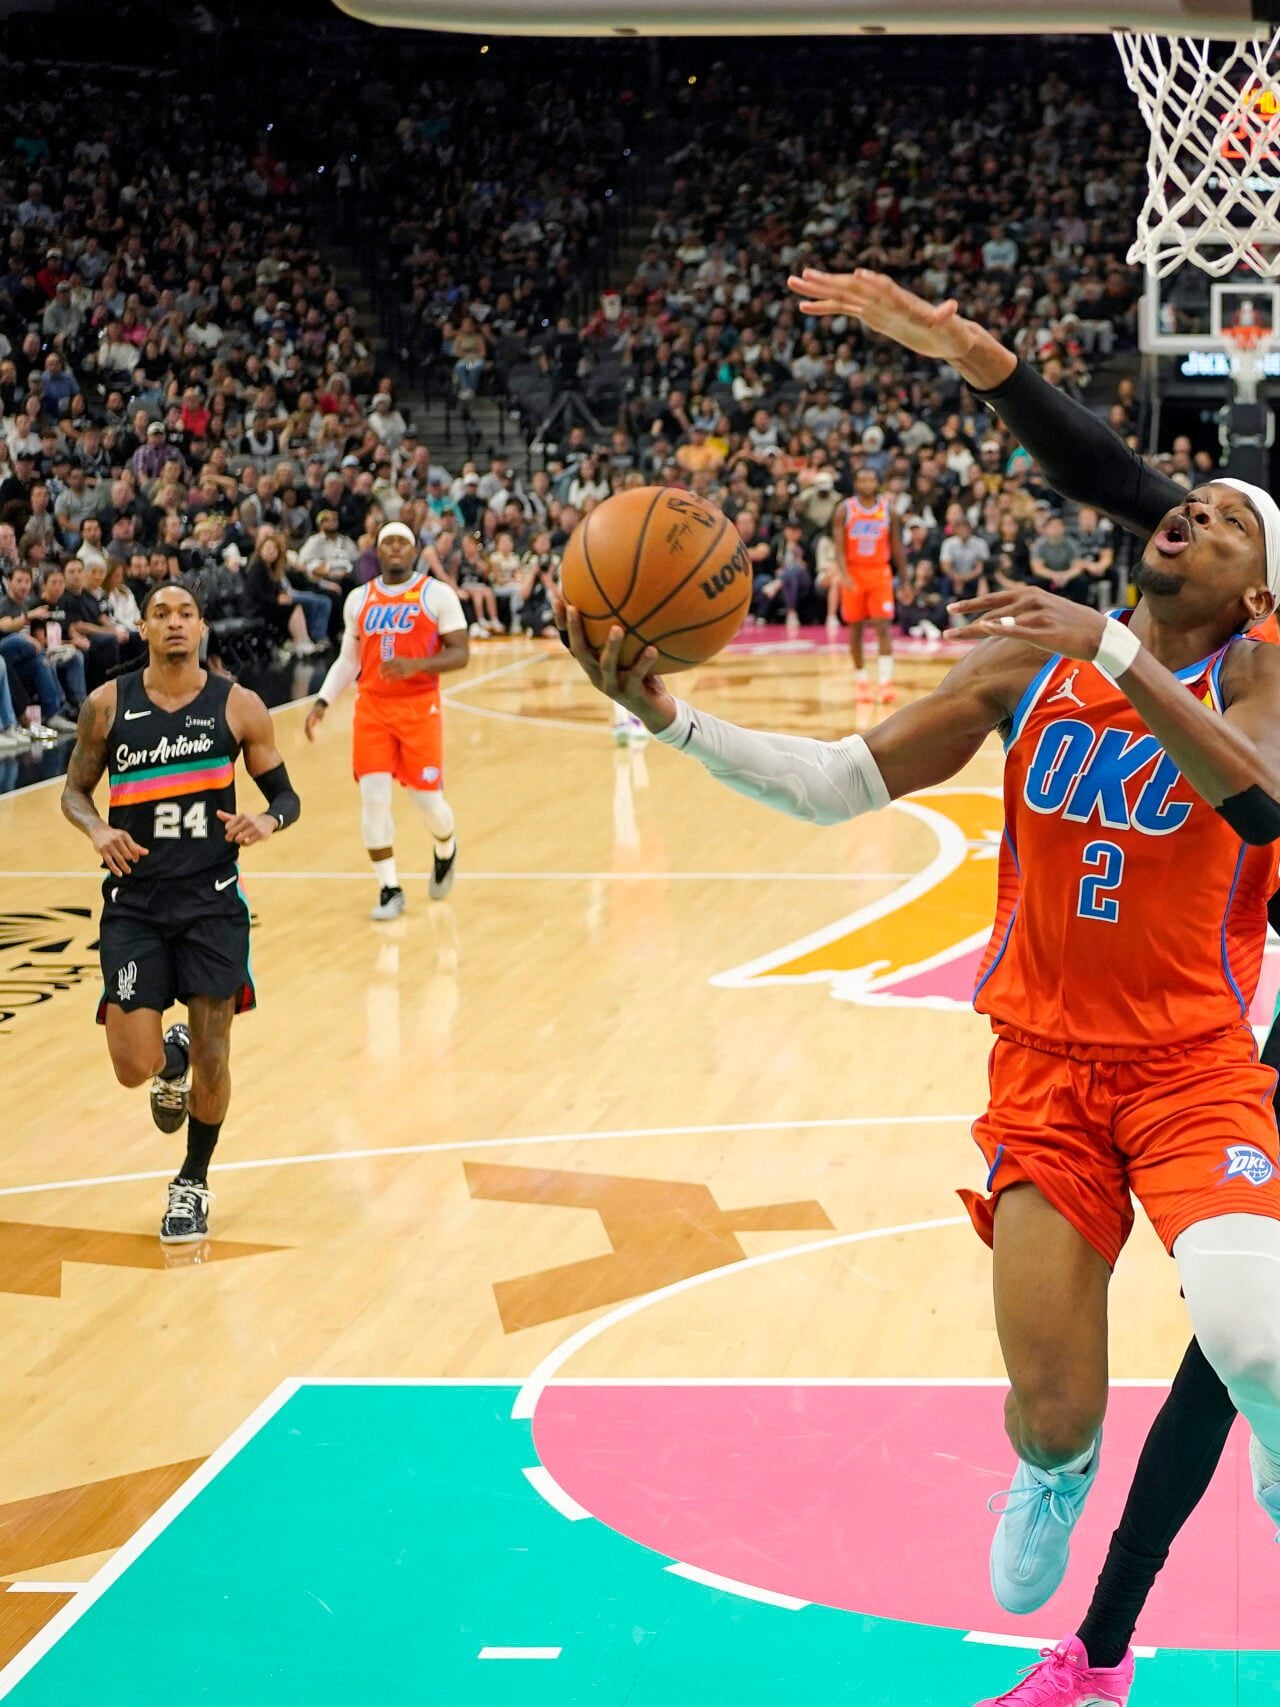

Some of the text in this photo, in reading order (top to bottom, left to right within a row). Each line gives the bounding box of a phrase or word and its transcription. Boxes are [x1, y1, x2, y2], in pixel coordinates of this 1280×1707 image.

[364, 603, 420, 636] OKC
[381, 634, 395, 661] 5
[116, 732, 214, 773] San Antonio
[1023, 719, 1194, 836] OKC
[153, 800, 208, 840] 24
[1076, 839, 1125, 924] 2
[1227, 1155, 1266, 1175] OKC
